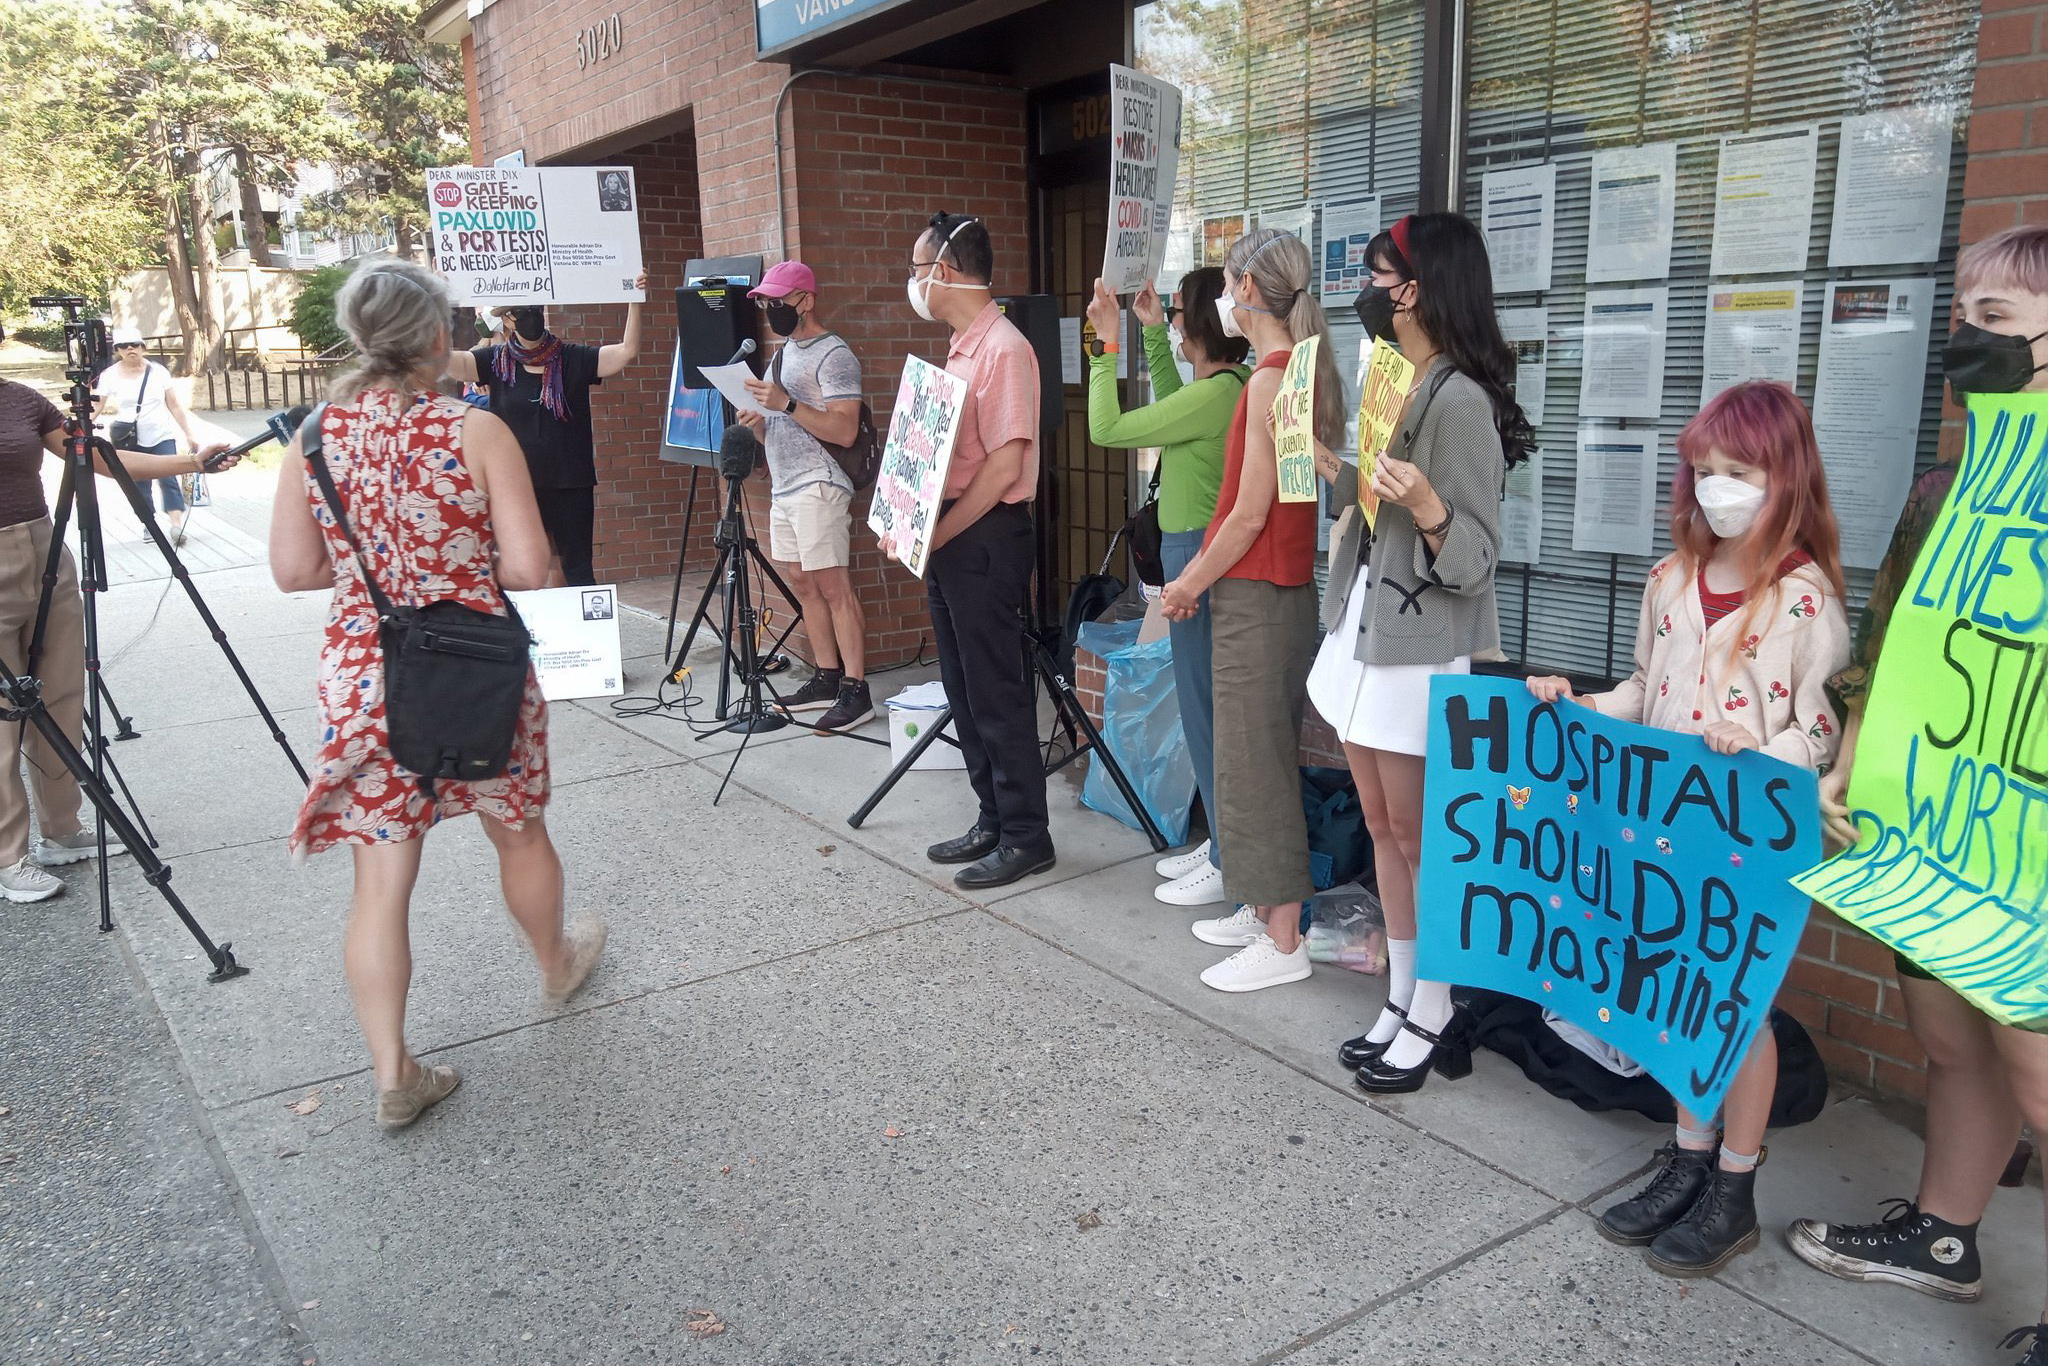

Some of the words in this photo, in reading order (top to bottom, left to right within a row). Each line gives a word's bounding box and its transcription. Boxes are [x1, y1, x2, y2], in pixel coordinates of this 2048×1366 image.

[795, 0, 855, 25] VAN
[576, 12, 622, 71] 5020
[1115, 74, 1129, 91] DEAR
[1072, 96, 1111, 141] 502
[1123, 97, 1153, 133] RESTORE
[1123, 131, 1145, 161] MASKS
[1146, 138, 1152, 161] IN
[429, 170, 452, 181] DEAR
[456, 170, 496, 181] MINISTER
[436, 187, 460, 202] STOP
[466, 195, 538, 211] KEEPING
[438, 211, 537, 231] PAXLOVID
[1118, 200, 1142, 229] COVID
[1143, 207, 1149, 226] IS
[441, 234, 454, 252] &
[458, 231, 498, 252] PCR
[497, 230, 546, 252] TESTS
[1115, 231, 1149, 257] AIRBORNE!
[441, 256, 457, 272] BC
[460, 254, 498, 272] NEEDS
[516, 253, 547, 271] HELP!
[533, 277, 551, 292] BC
[1294, 341, 1310, 391] 33
[1388, 356, 1404, 384] HAD
[1298, 390, 1308, 416] ARE
[1375, 377, 1404, 427] COVID
[933, 400, 956, 437] Red
[1278, 433, 1307, 458] CURRENTLY
[1280, 453, 1314, 497] INFECTED
[1924, 618, 2048, 787] STIL
[1445, 694, 1796, 851] HOSPITALS
[1906, 734, 2048, 913] WORT
[1697, 876, 1777, 1007] BE
